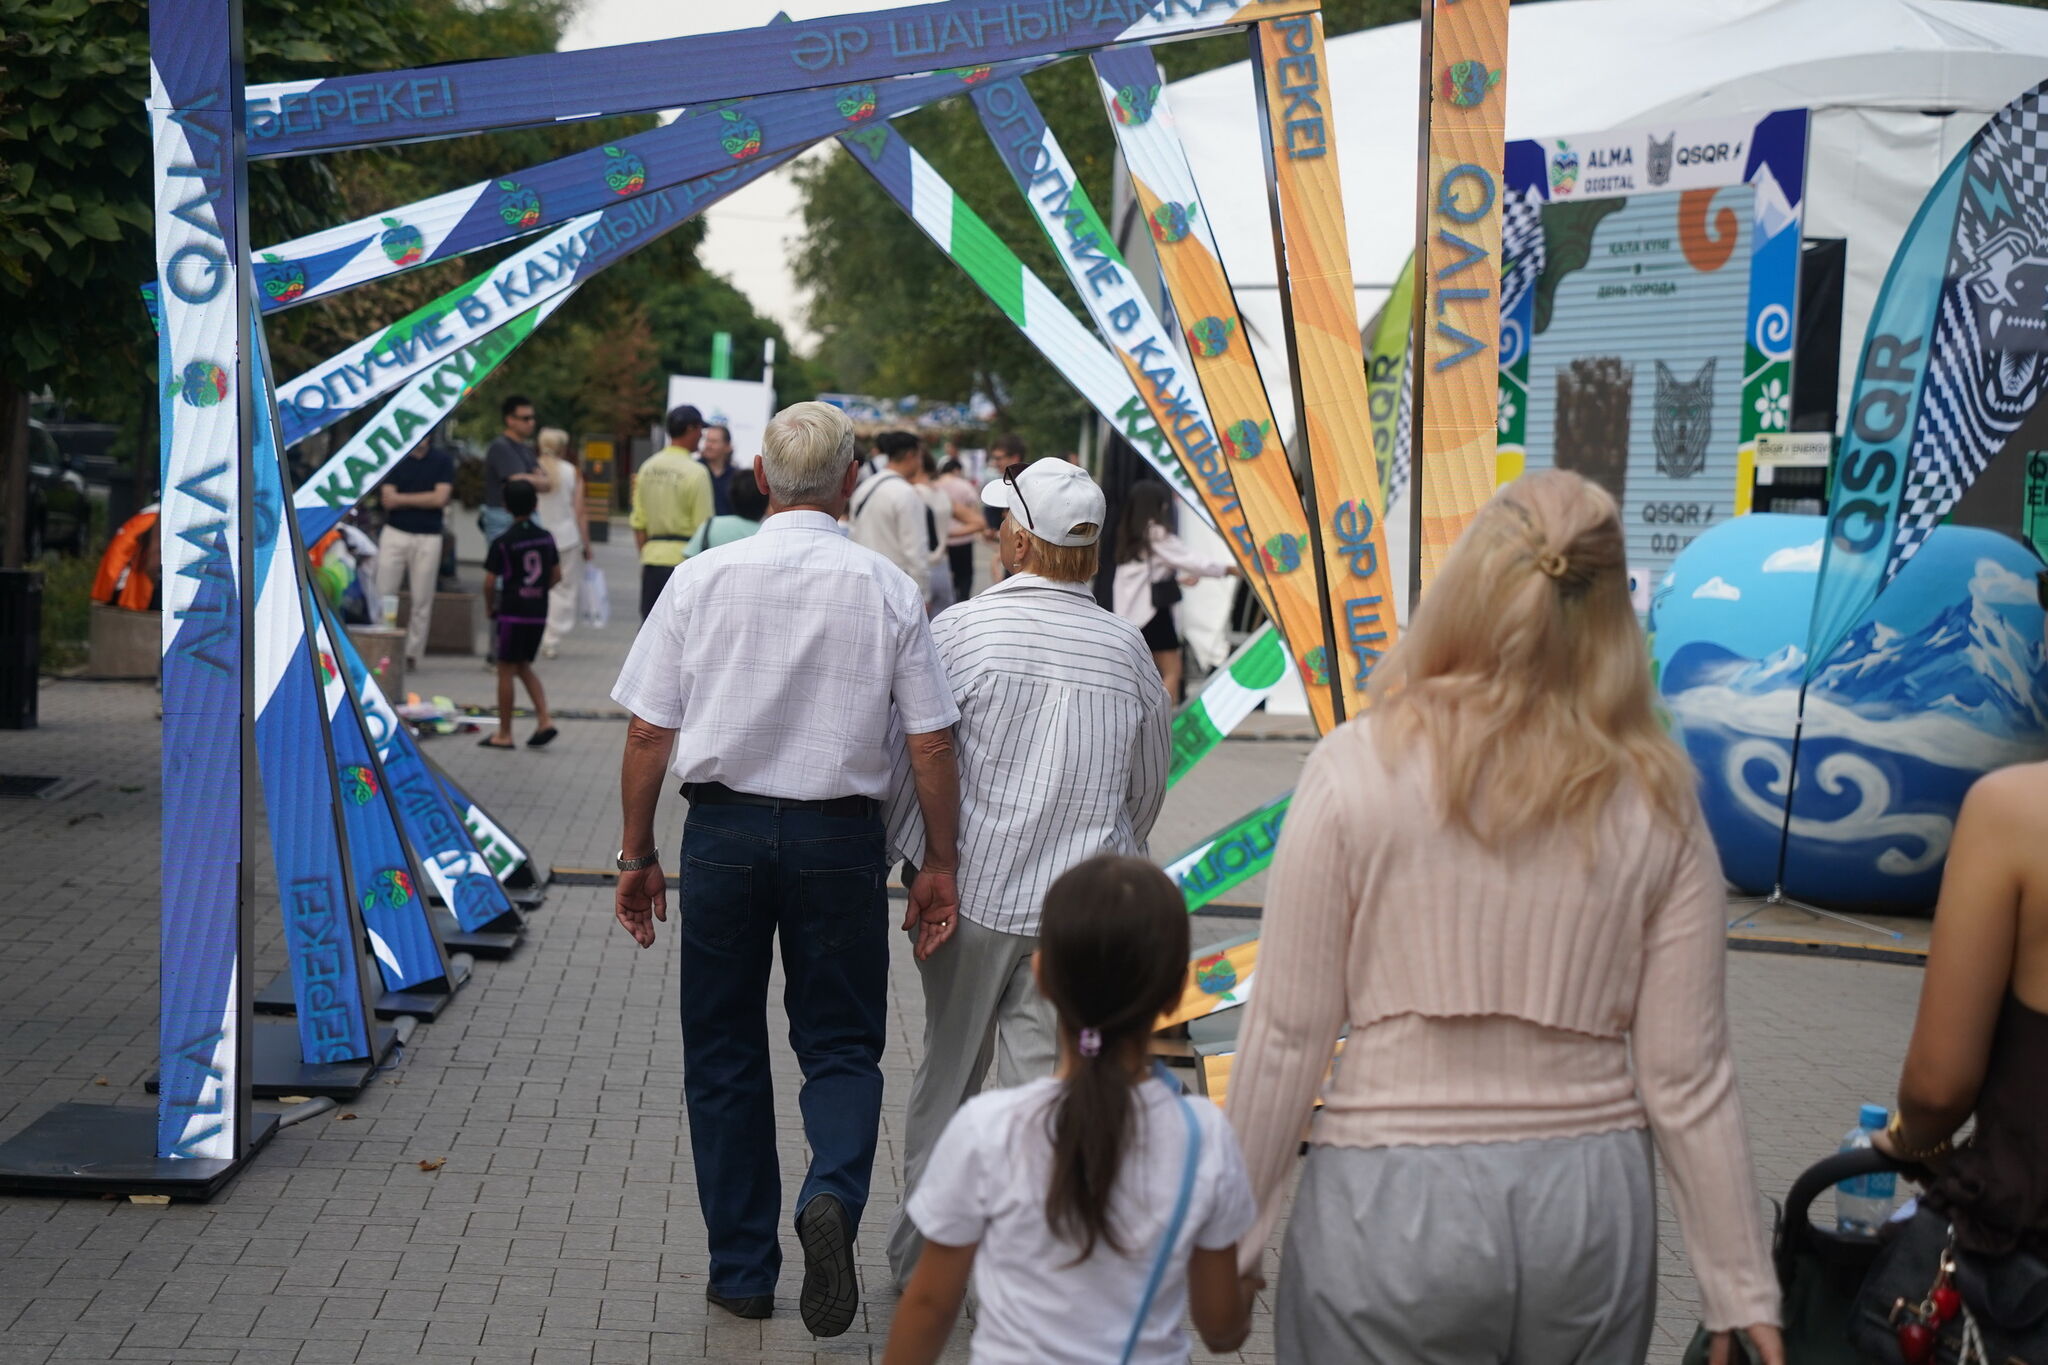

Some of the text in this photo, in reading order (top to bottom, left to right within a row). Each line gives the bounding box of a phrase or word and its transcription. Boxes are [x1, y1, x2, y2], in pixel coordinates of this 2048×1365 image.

[1586, 147, 1634, 169] ALMA
[1676, 143, 1729, 166] QSQR
[1584, 175, 1635, 194] DIGITAL
[455, 294, 492, 328] В
[1108, 298, 1141, 333] В
[1831, 333, 1924, 555] QSQR
[1642, 502, 1700, 524] QSQR
[522, 550, 543, 586] 9
